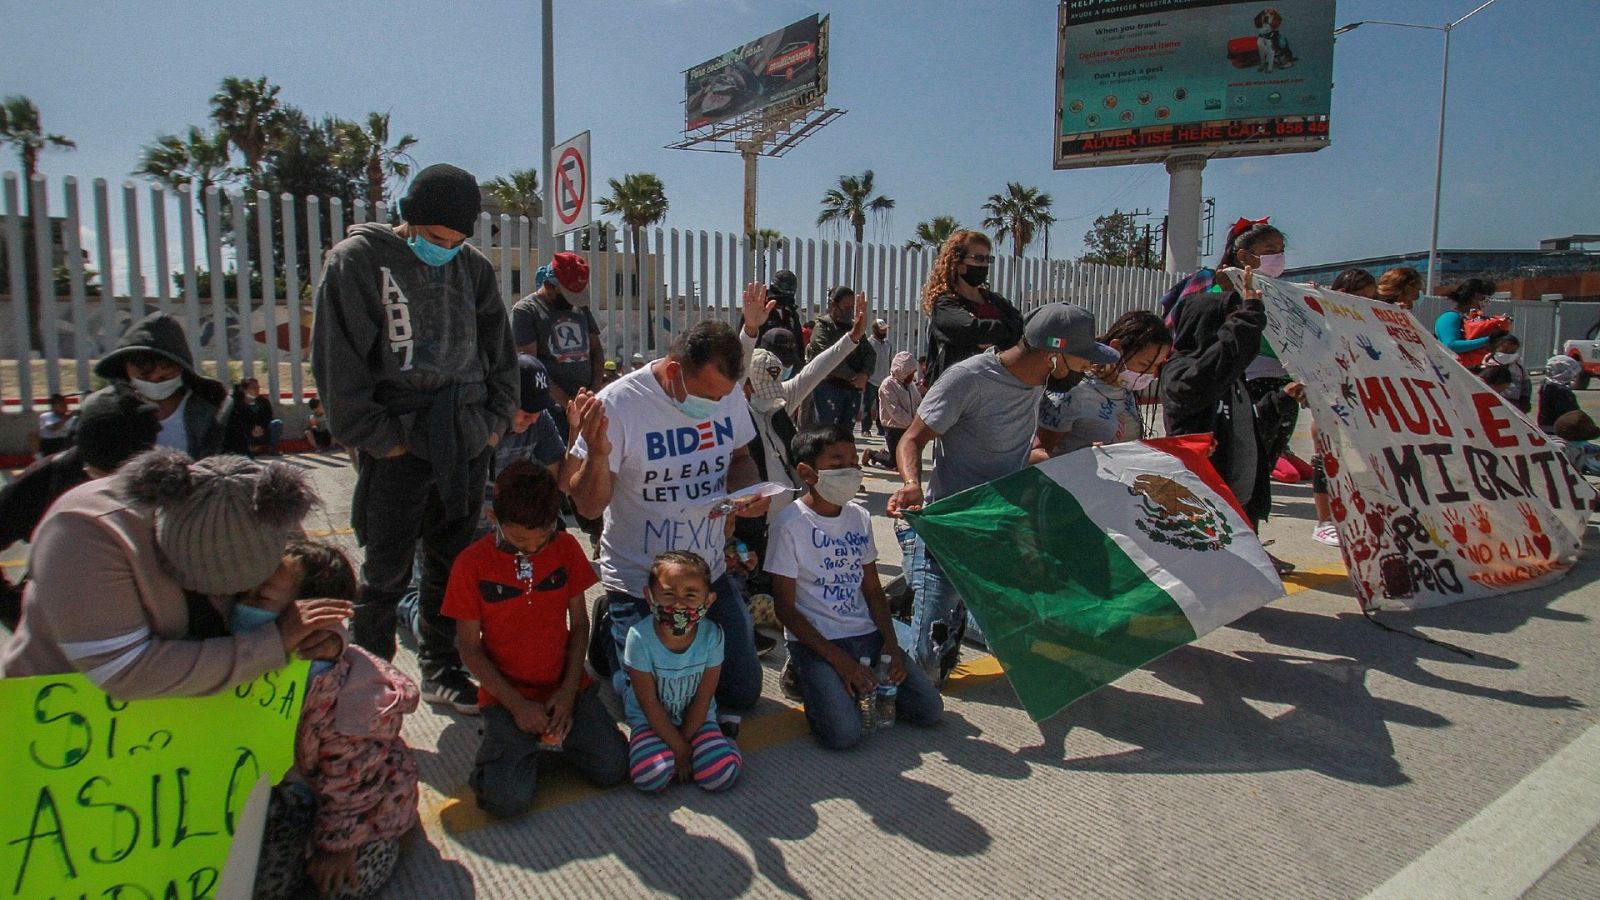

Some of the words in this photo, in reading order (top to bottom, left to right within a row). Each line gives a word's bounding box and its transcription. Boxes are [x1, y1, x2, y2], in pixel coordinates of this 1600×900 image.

[1094, 27, 1118, 36] When
[1120, 25, 1136, 33] you
[1118, 68, 1137, 78] pack
[1145, 65, 1164, 75] pest
[1177, 125, 1221, 142] HERE
[1355, 376, 1547, 448] MUJE
[645, 416, 734, 461] BIDEN
[643, 486, 680, 502] LET
[686, 481, 712, 500] US
[1467, 544, 1493, 564] NO
[1499, 542, 1511, 560] A
[1514, 534, 1536, 559] LA
